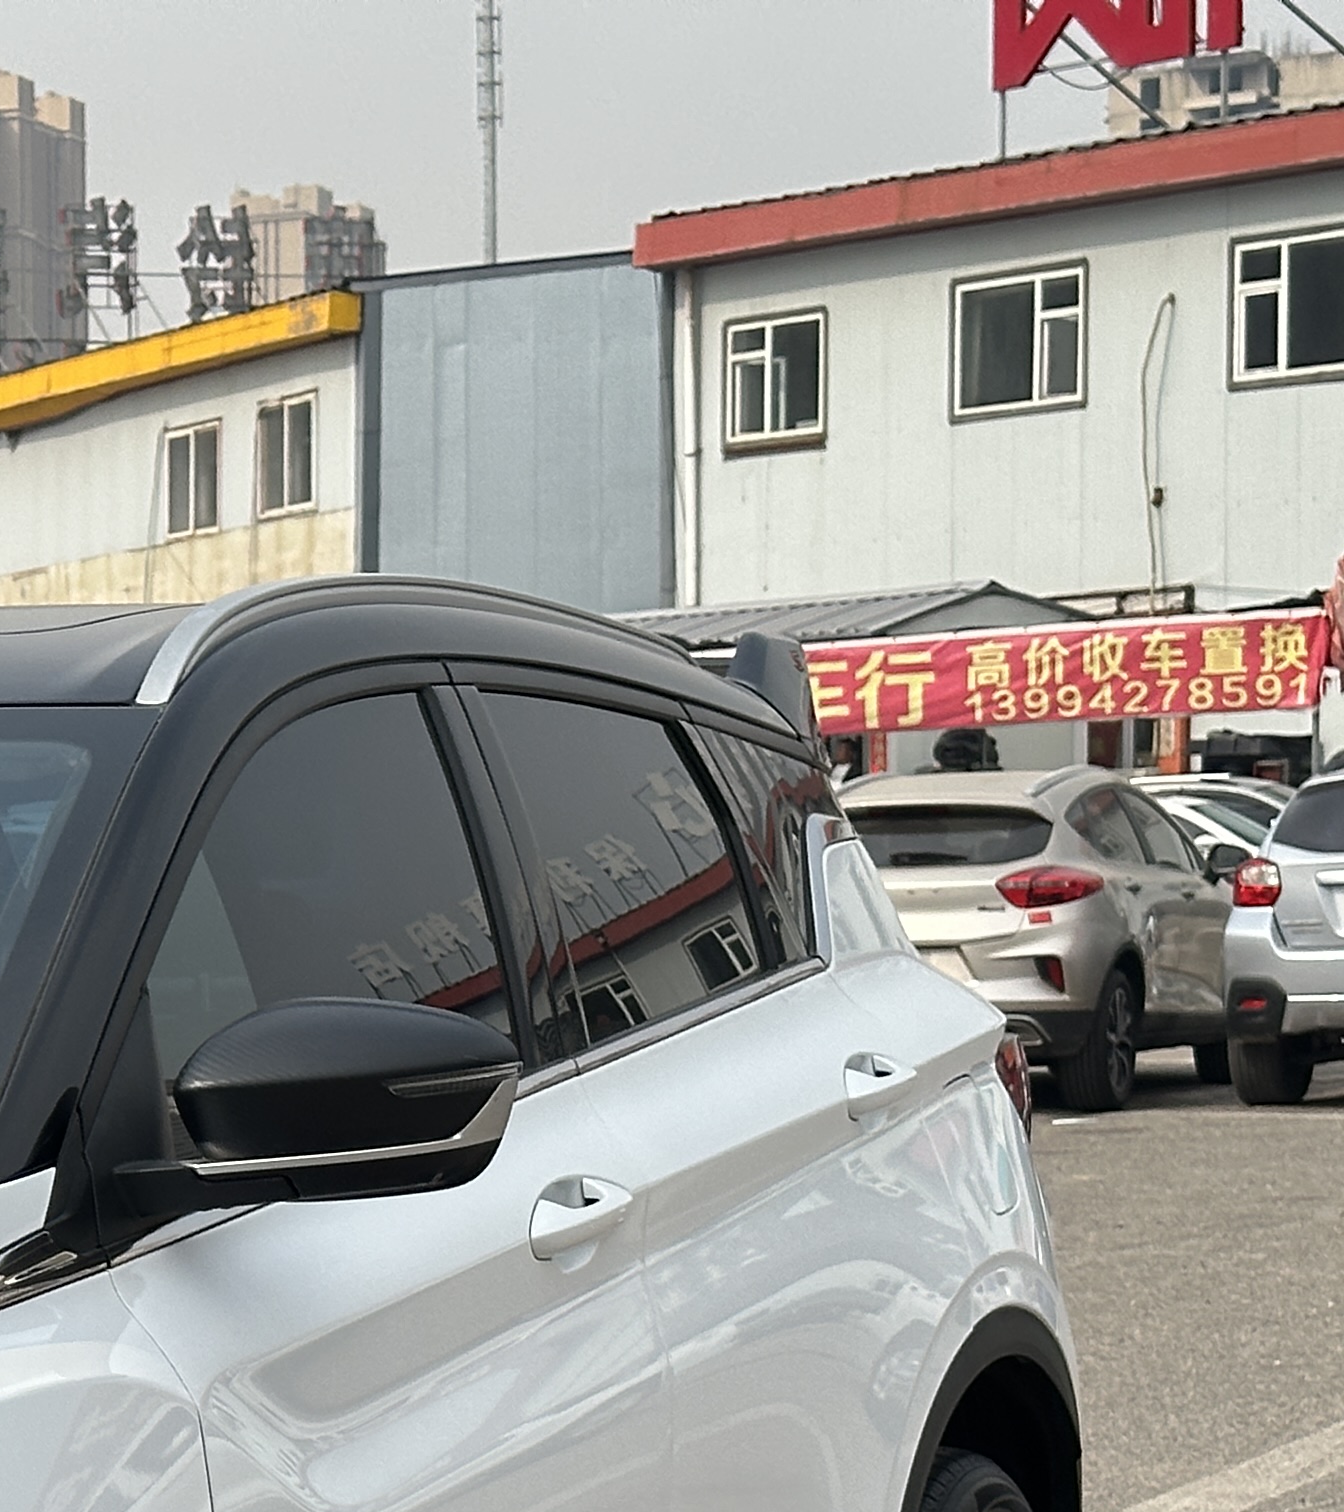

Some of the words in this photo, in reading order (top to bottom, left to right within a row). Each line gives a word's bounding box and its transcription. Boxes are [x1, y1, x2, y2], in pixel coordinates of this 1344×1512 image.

[965, 622, 1309, 692] 高价收车置换
[963, 672, 1309, 723] 13994278591
